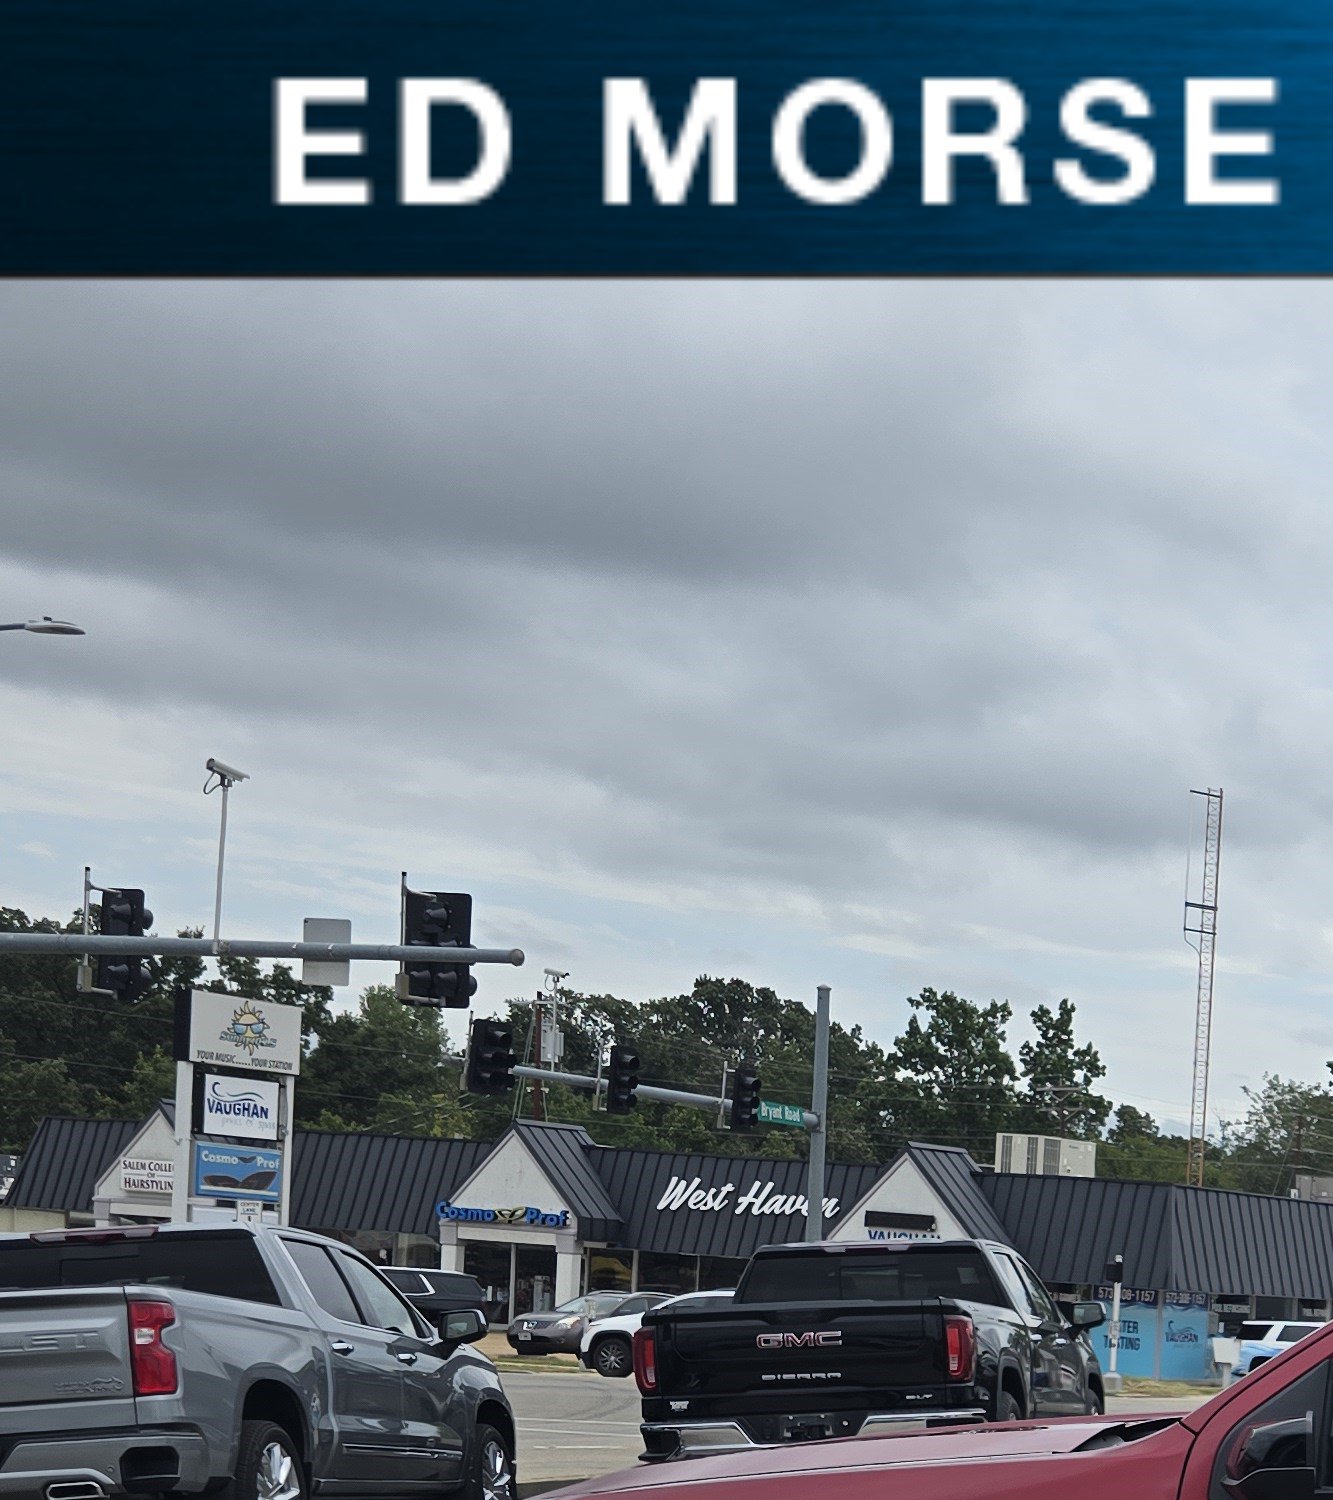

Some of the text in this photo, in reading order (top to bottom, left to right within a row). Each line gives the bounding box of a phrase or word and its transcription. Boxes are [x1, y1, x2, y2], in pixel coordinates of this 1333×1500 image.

[196, 1050, 214, 1060] YOUR
[251, 1057, 268, 1068] YOUR
[268, 1060, 293, 1071] STATION
[206, 1098, 269, 1119] VAUGHAN
[760, 1102, 801, 1122] Bryant Road
[122, 1160, 147, 1171] SALEM
[201, 1150, 280, 1169] Cosmo Prof
[656, 1176, 735, 1212] West
[435, 1200, 570, 1227] Cosmo Prof
[1098, 1286, 1156, 1302] 57308-1157
[756, 1331, 843, 1349] GMC
[1103, 1335, 1141, 1351] TTING
